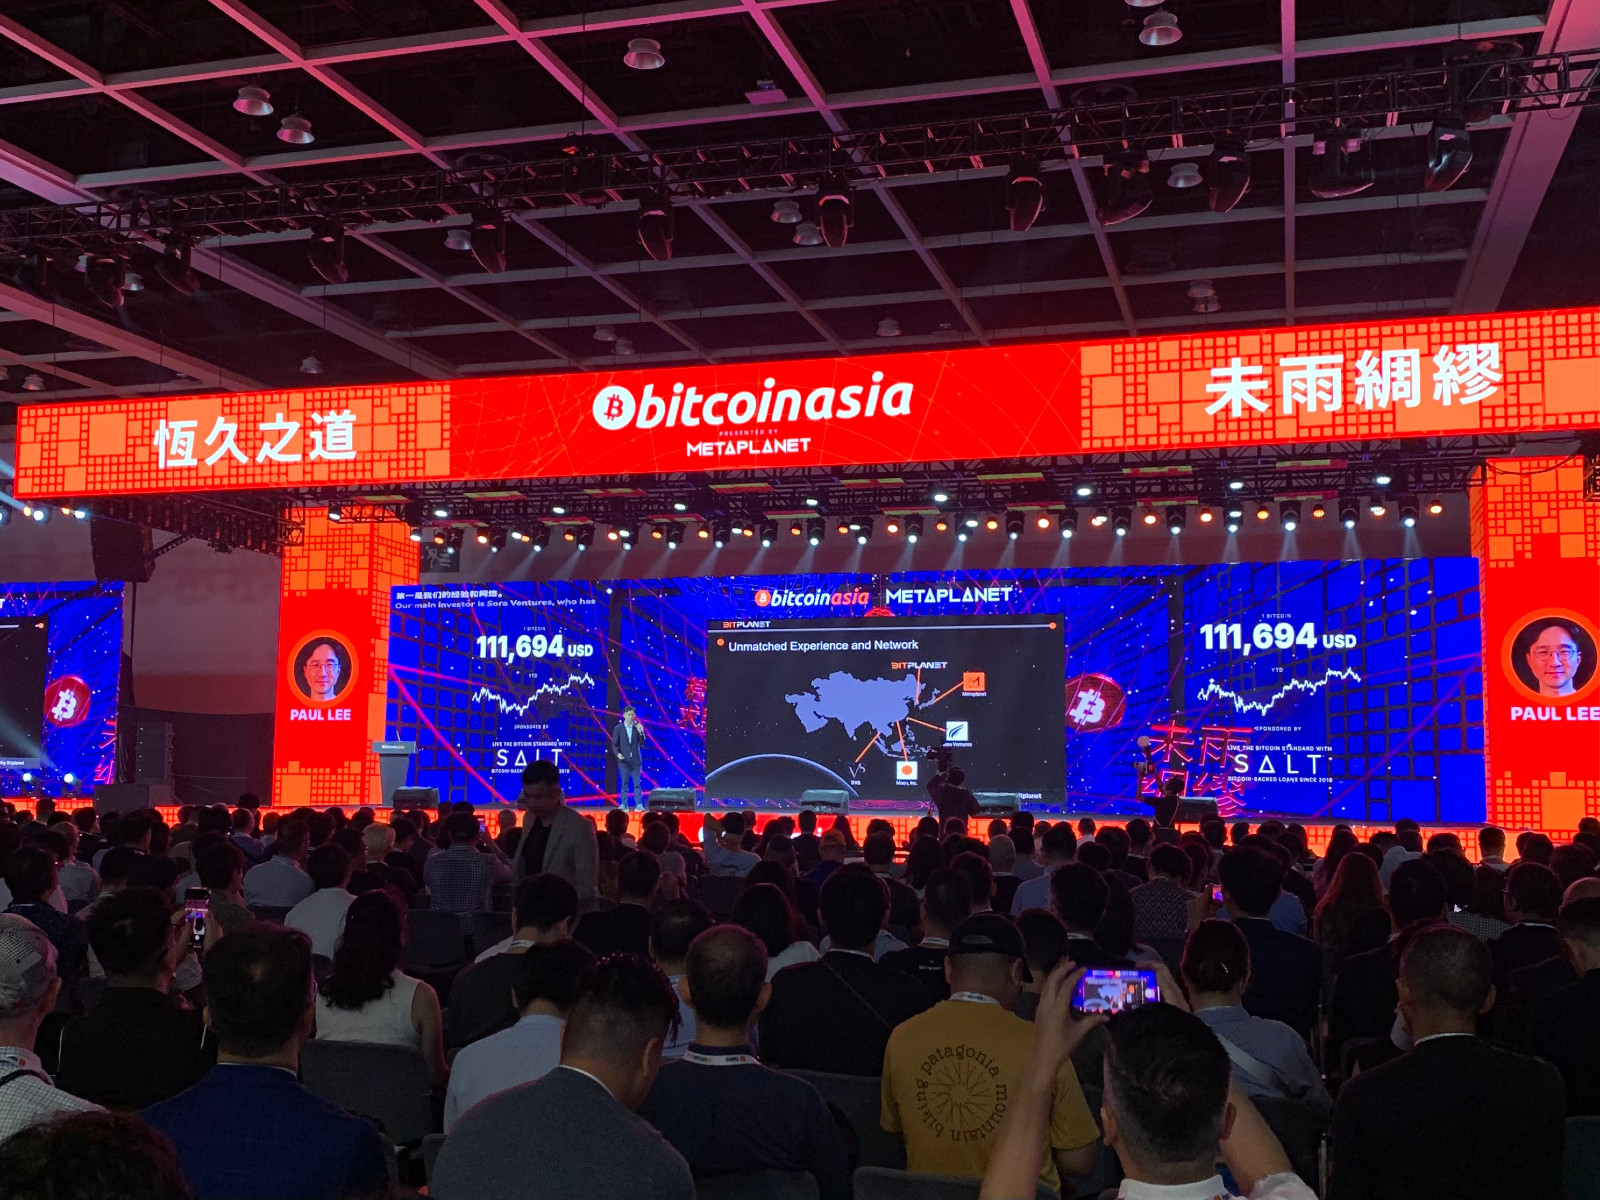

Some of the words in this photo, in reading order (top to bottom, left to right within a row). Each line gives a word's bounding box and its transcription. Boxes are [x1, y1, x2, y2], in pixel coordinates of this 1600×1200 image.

[635, 371, 914, 429] bitcoinasia
[154, 409, 356, 469] 恆久之道
[686, 437, 811, 457] METAPLANET
[556, 598, 577, 606] who
[770, 588, 870, 607] bitcoinasia
[885, 587, 1013, 604] METAPLANET
[476, 634, 564, 664] 111,694
[567, 644, 594, 657] USD
[728, 641, 787, 652] Unmatched
[790, 641, 849, 653] Experience
[851, 640, 871, 650] and
[874, 640, 919, 650] Network
[1200, 622, 1318, 656] 111,694
[1322, 634, 1357, 648] USD
[891, 661, 948, 670] BITPLANET
[290, 709, 325, 721] PAUL
[327, 709, 351, 721] LEE
[1510, 706, 1562, 721] PAUL
[1566, 706, 1600, 721] LEE
[1234, 753, 1322, 775] SALT
[1018, 792, 1041, 800] tplanet
[921, 1044, 1000, 1079] patagonia
[916, 1078, 944, 1138] biking
[951, 1083, 1008, 1145] mountain
